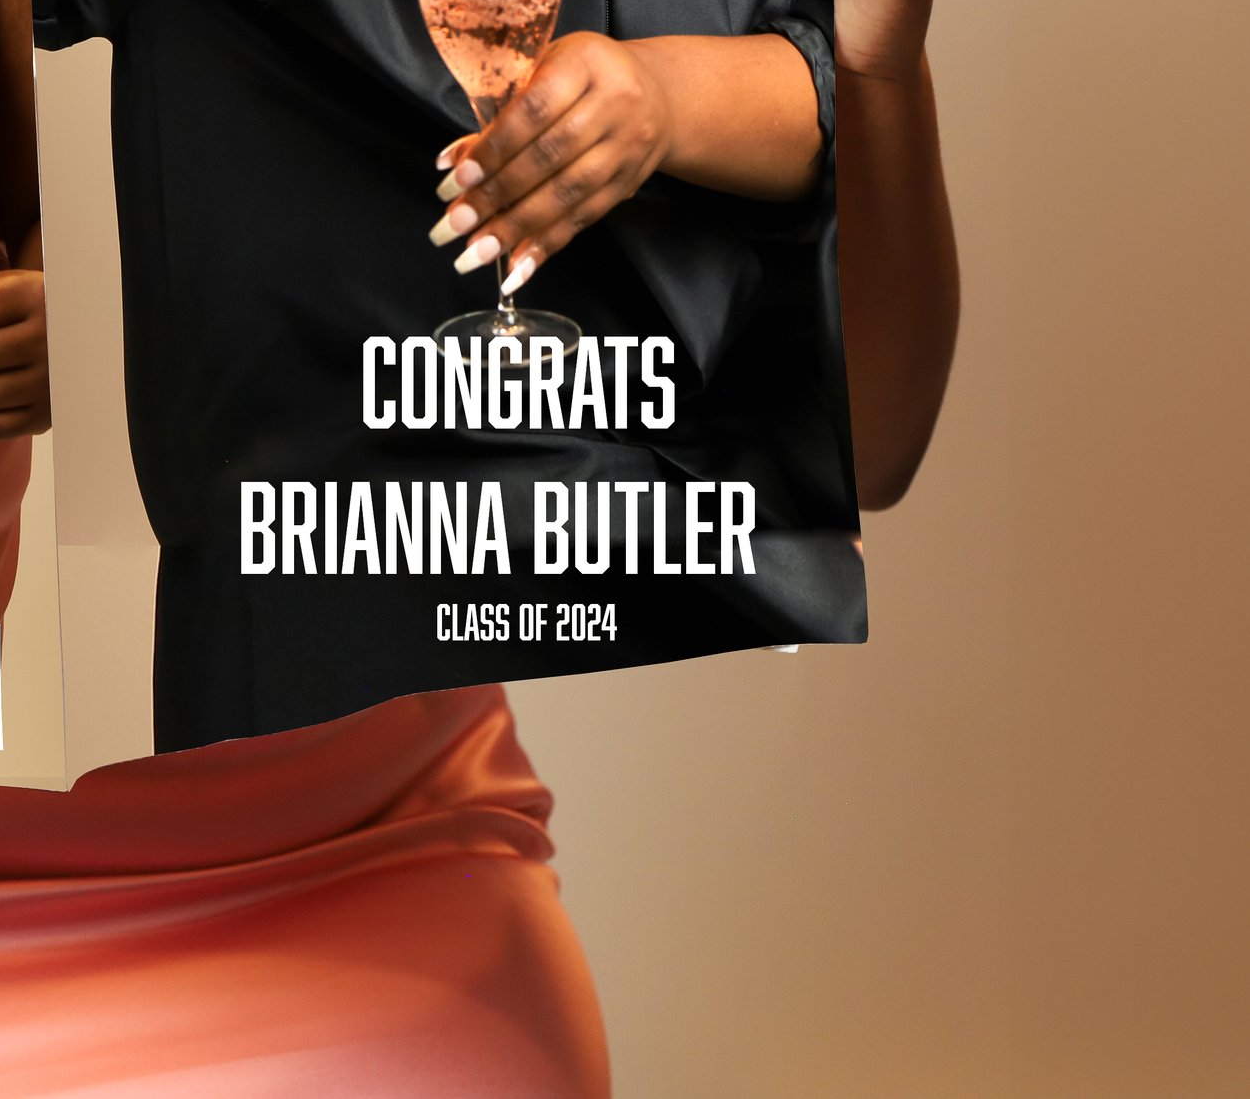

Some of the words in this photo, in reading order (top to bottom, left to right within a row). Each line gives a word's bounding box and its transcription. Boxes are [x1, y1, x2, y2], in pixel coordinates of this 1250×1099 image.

[362, 335, 676, 430] CONGRATS
[240, 481, 512, 576] BRIANNA
[534, 481, 757, 576] BUTLER
[436, 603, 511, 642] CLASS
[519, 603, 549, 642] OF
[556, 603, 620, 642] 2024
